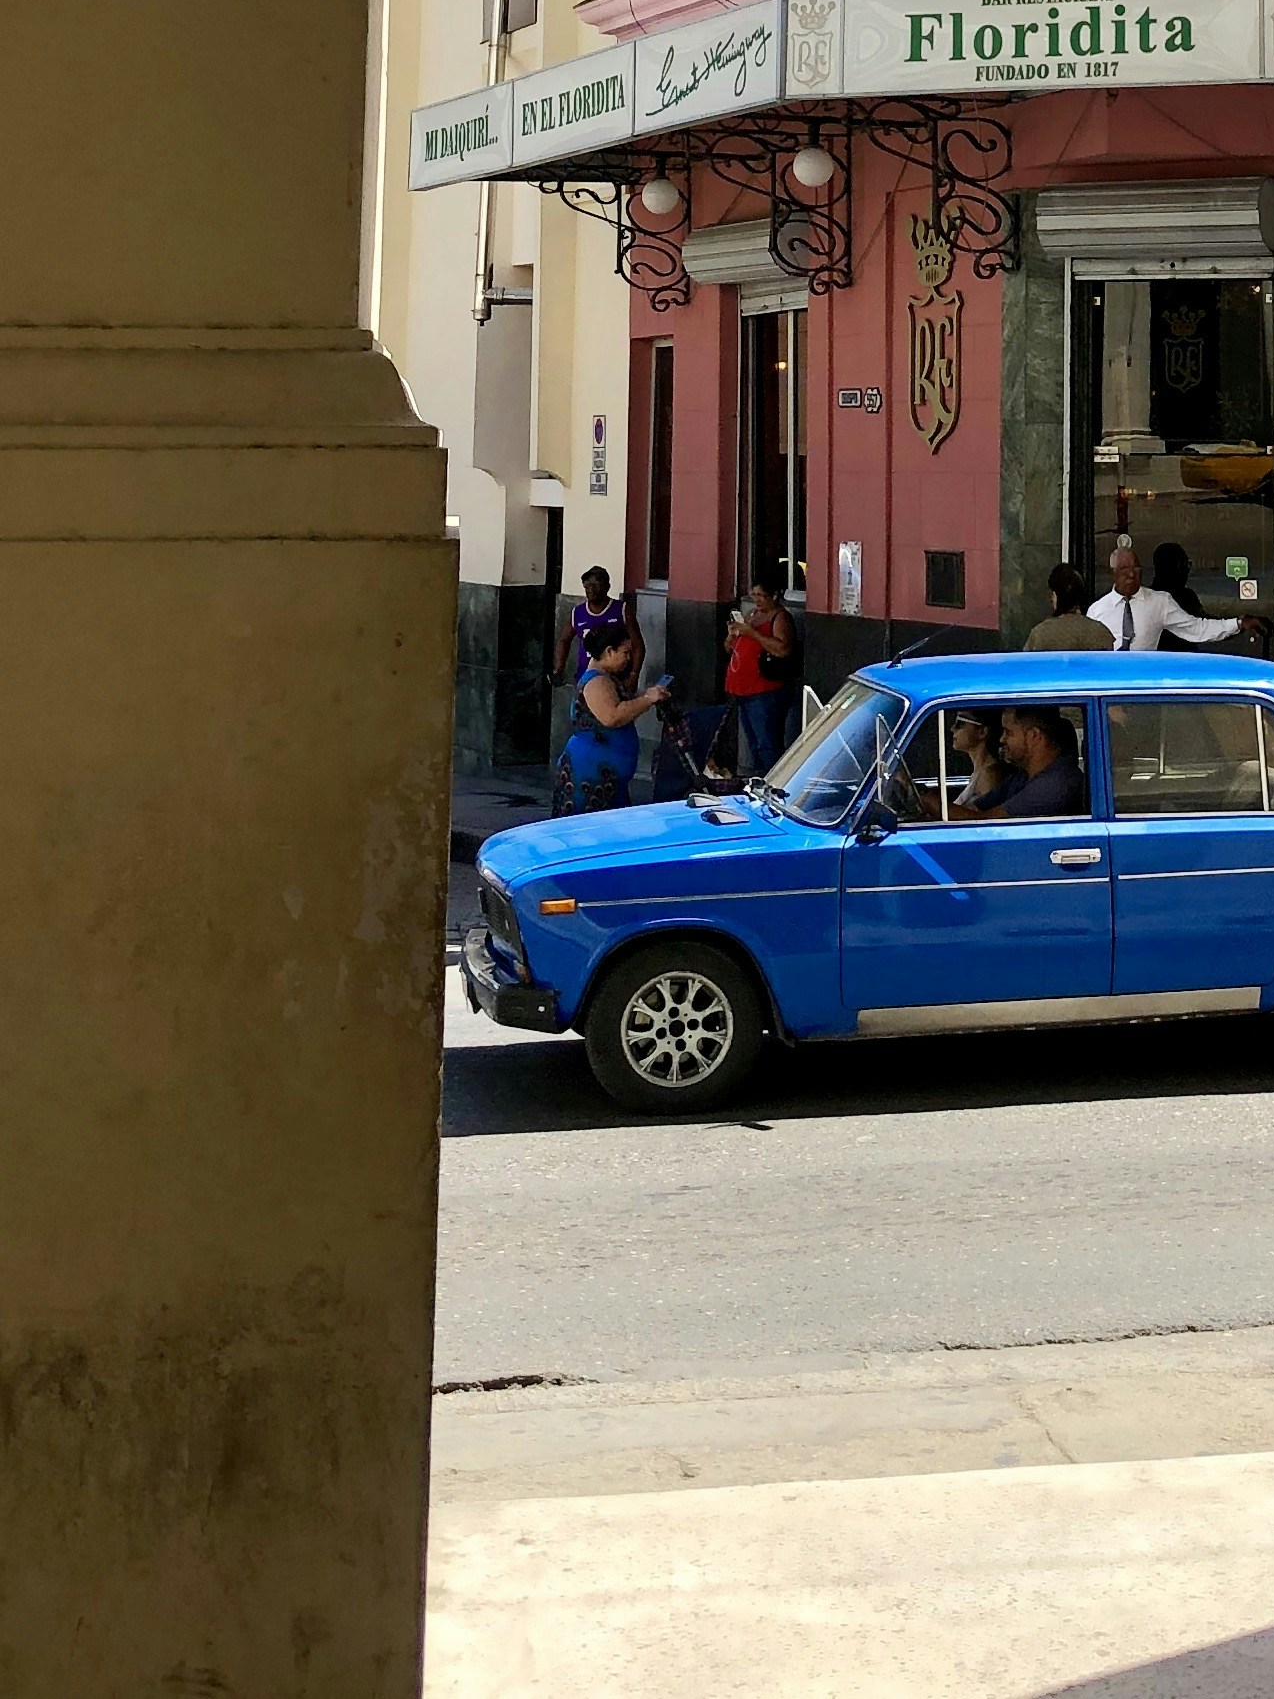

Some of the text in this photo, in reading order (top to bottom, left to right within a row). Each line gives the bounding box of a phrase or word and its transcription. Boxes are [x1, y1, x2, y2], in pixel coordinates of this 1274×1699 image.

[903, 3, 1196, 63] Floridita
[975, 61, 1120, 82] FUNDADO EN 1817
[521, 73, 626, 137] EN EL FLORIDITA
[424, 129, 439, 163] MI
